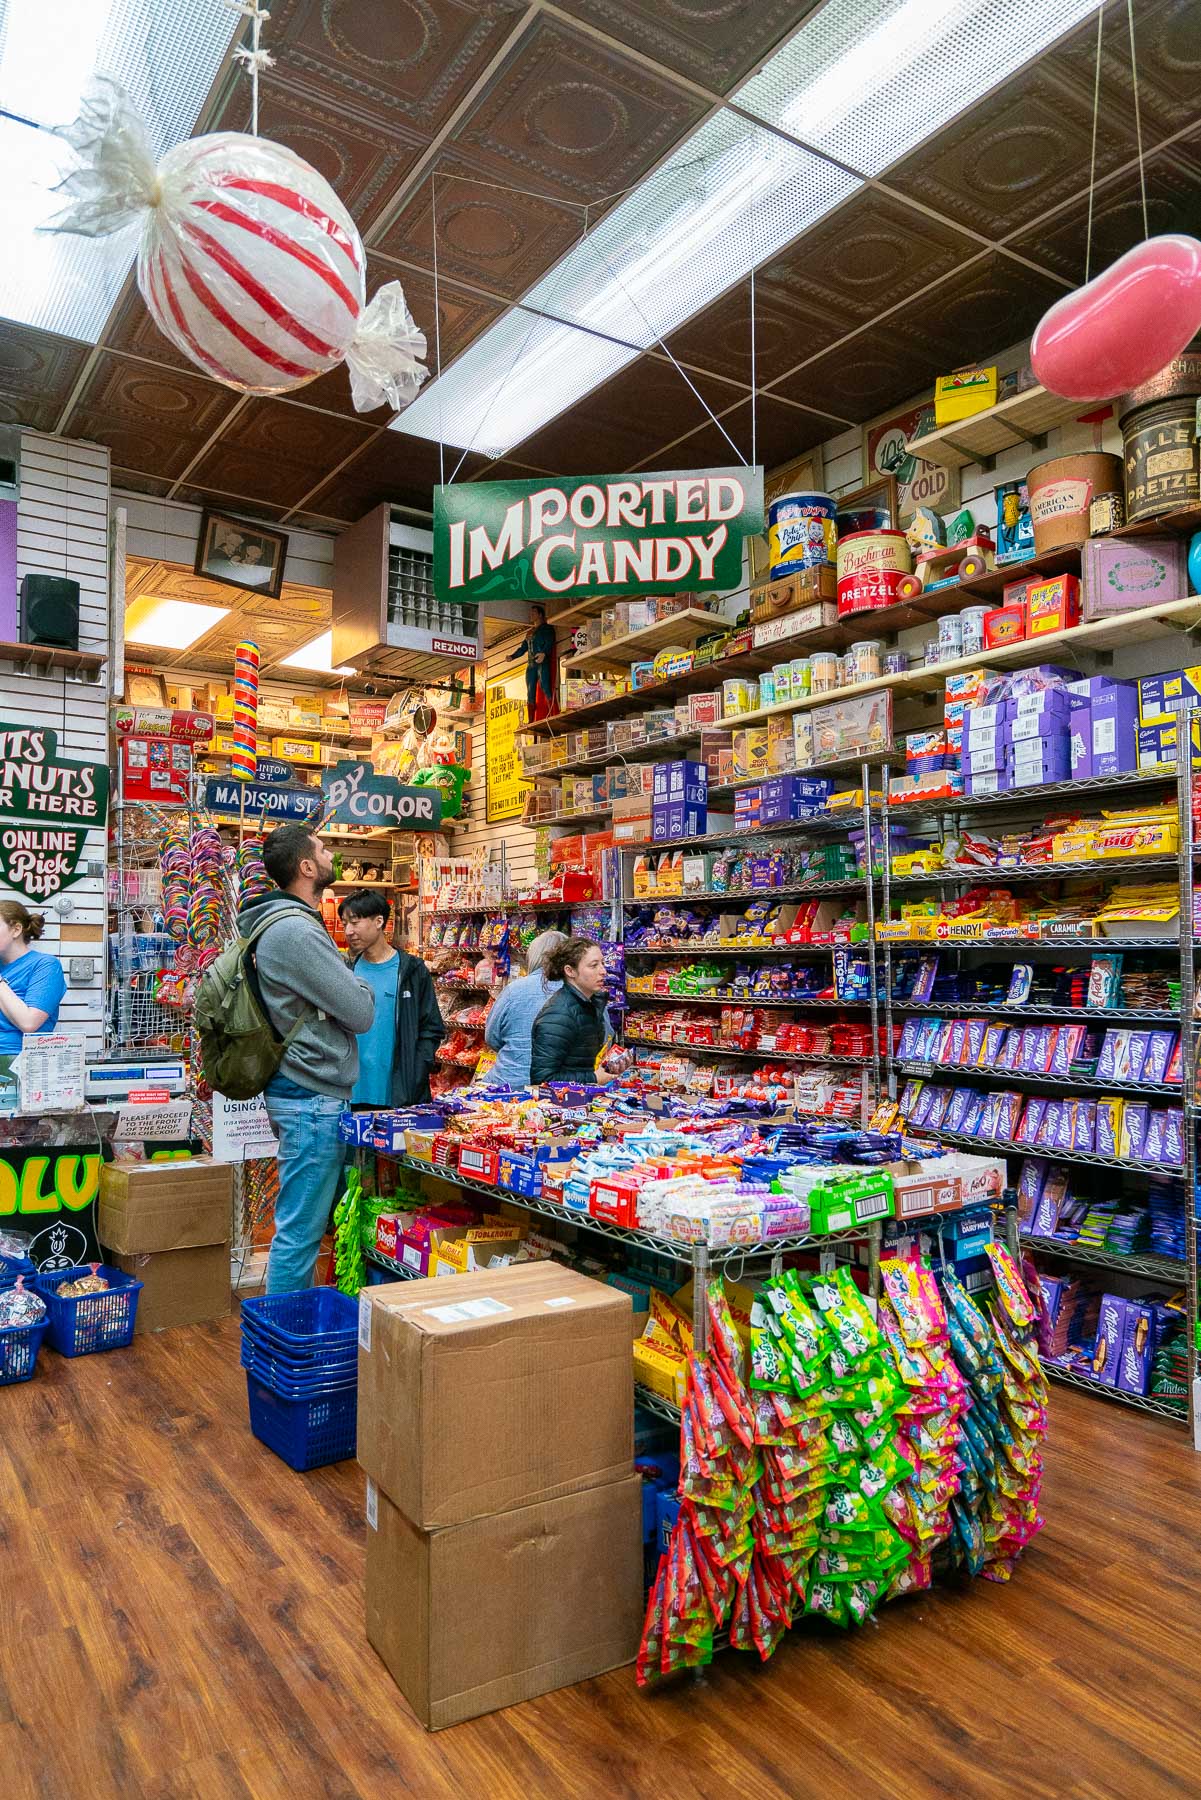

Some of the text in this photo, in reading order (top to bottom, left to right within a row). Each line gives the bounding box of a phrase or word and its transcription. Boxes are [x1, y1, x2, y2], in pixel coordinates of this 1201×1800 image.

[1127, 429, 1197, 474] MILLE
[911, 472, 946, 501] COLD
[1034, 494, 1074, 512] AMERICAN
[1040, 503, 1065, 516] MIXED
[449, 476, 745, 589] IMPORTED
[532, 523, 729, 593] CANDY
[842, 545, 897, 570] Bachman
[433, 640, 476, 656] REZNOR
[3, 761, 95, 798] NUTS
[255, 760, 287, 775] LINTON
[259, 772, 274, 782] ST.
[215, 786, 314, 815] MADISON ST
[329, 765, 365, 806] BY
[27, 793, 98, 817] HERE
[349, 791, 434, 825] COLOR
[2, 830, 77, 850] ONLINE
[8, 850, 73, 883] Pick
[937, 924, 982, 937] OH HENRY!
[1050, 923, 1082, 933] CARAMILK
[904, 1025, 915, 1052] Milka
[915, 1032, 925, 1056] Milka
[952, 1023, 964, 1052] Milka
[969, 1023, 981, 1055] Milka
[988, 1031, 999, 1056] Milka
[1008, 1032, 1021, 1058] Milka
[1025, 1032, 1037, 1060] Milka
[1033, 1038, 1046, 1068] Milka
[1054, 1039, 1068, 1070] Milka
[1101, 1045, 1114, 1075] Milka
[1129, 1039, 1144, 1070] Milka
[1152, 1039, 1166, 1070] Milka
[120, 1111, 189, 1122] PLEASE PROCEED
[223, 1102, 257, 1113] USING
[900, 1092, 910, 1118] Milka
[919, 1090, 932, 1115] Milka
[930, 1097, 941, 1124] Milka
[952, 1090, 964, 1121] Milka
[966, 1105, 978, 1131] Milka
[981, 1105, 992, 1135] Milka
[998, 1104, 1010, 1137] Milka
[1028, 1103, 1040, 1133] Milka
[1046, 1106, 1060, 1135] Milka
[1058, 1113, 1072, 1145] Milka
[1077, 1114, 1090, 1146] Milka
[1127, 1112, 1140, 1149] Milka
[1099, 1117, 1113, 1153] Milka
[1147, 1125, 1162, 1157] Milka
[1166, 1122, 1181, 1158] Milka
[474, 1230, 513, 1239] TOBLERONE
[786, 1313, 816, 1350] TAPPSY
[833, 1308, 865, 1347] TAPPSY
[1104, 1306, 1121, 1345] Milka
[760, 1331, 776, 1378] TAPPSY
[1123, 1346, 1140, 1386] Milka
[1161, 1380, 1188, 1395] Andes
